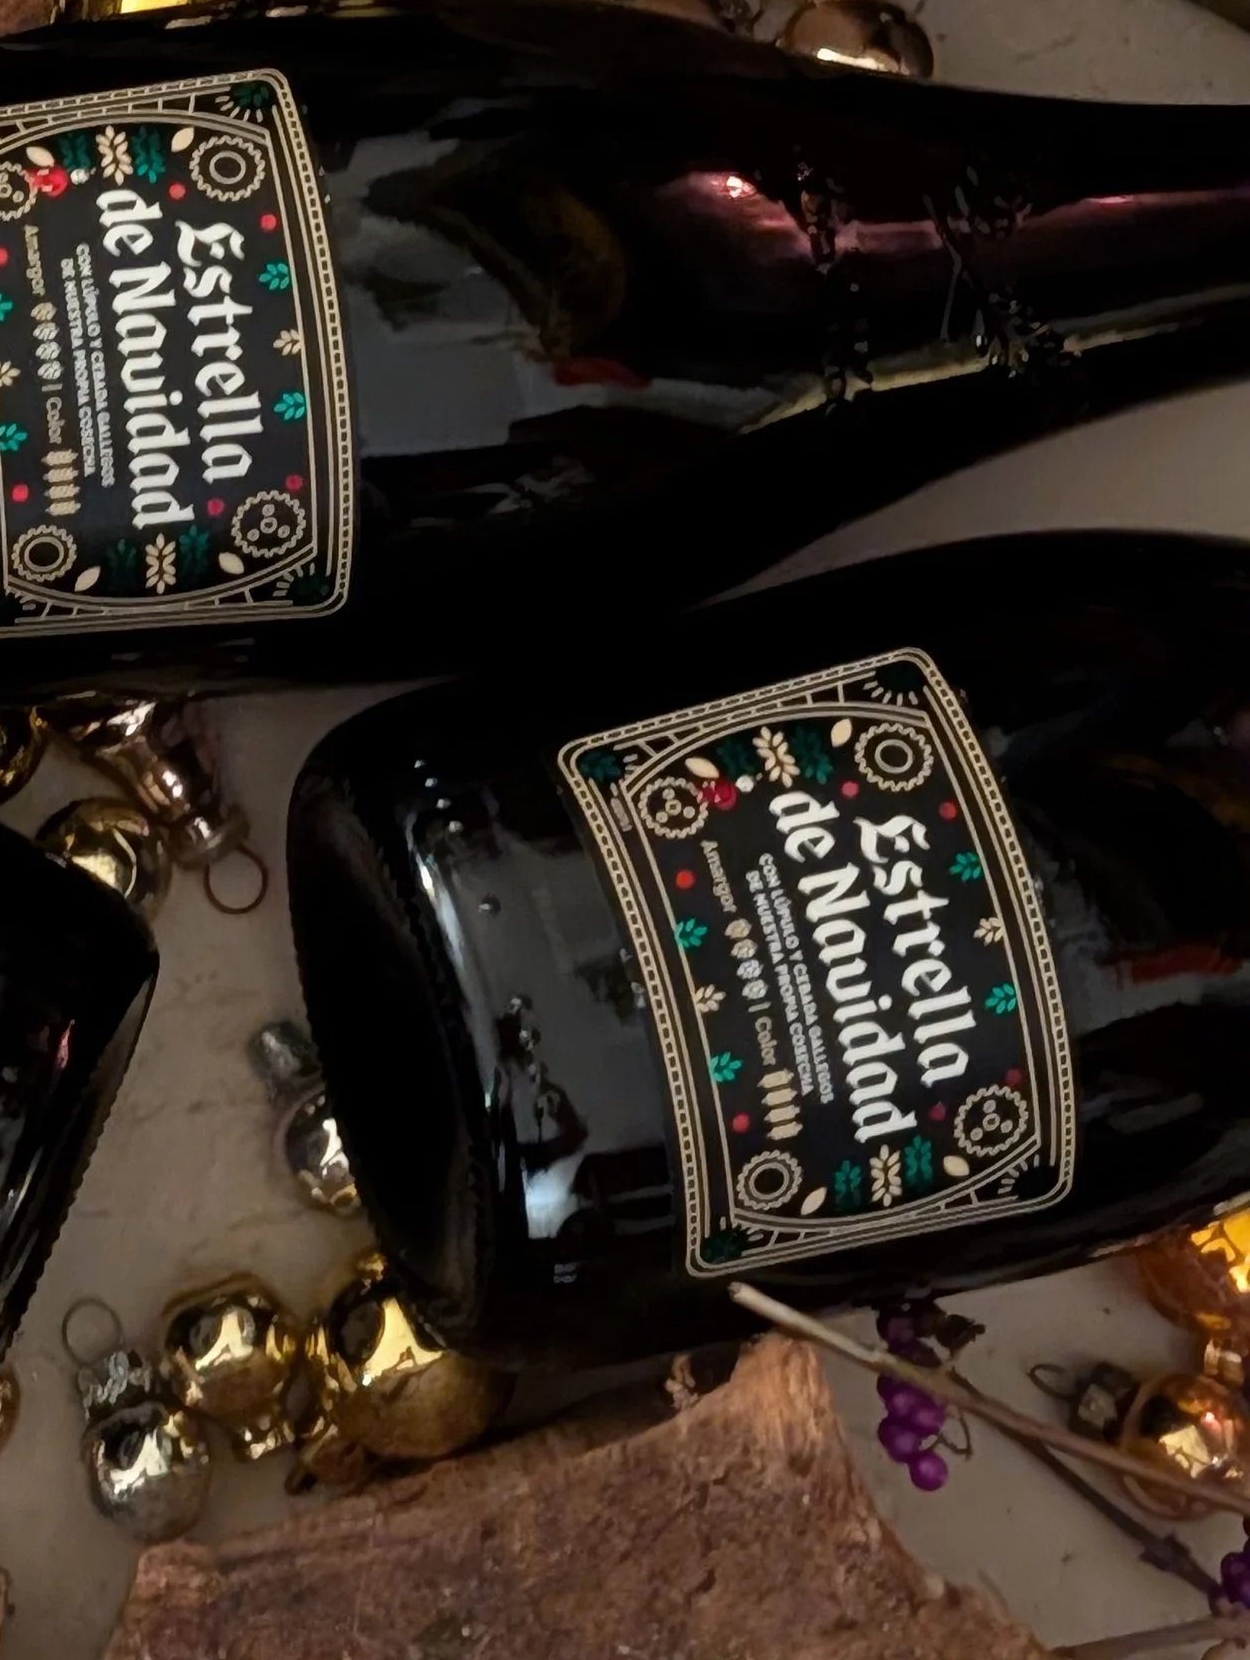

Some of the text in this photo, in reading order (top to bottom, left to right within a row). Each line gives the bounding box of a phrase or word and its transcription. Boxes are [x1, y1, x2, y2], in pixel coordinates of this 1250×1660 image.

[96, 190, 194, 529] de Navidad
[175, 221, 263, 483] Estrella
[701, 841, 777, 1065] Amargor Color
[759, 853, 781, 888] CON
[769, 792, 917, 1143] de Navidad
[789, 950, 803, 960] Y
[854, 815, 976, 1086] Estrella
[753, 893, 784, 964] NUESTRA
[774, 964, 799, 1022] PROPIA
[790, 1022, 821, 1095] COSECHA
[793, 963, 818, 1026] CEBADA
[808, 1025, 834, 1104] GALLEGOS
